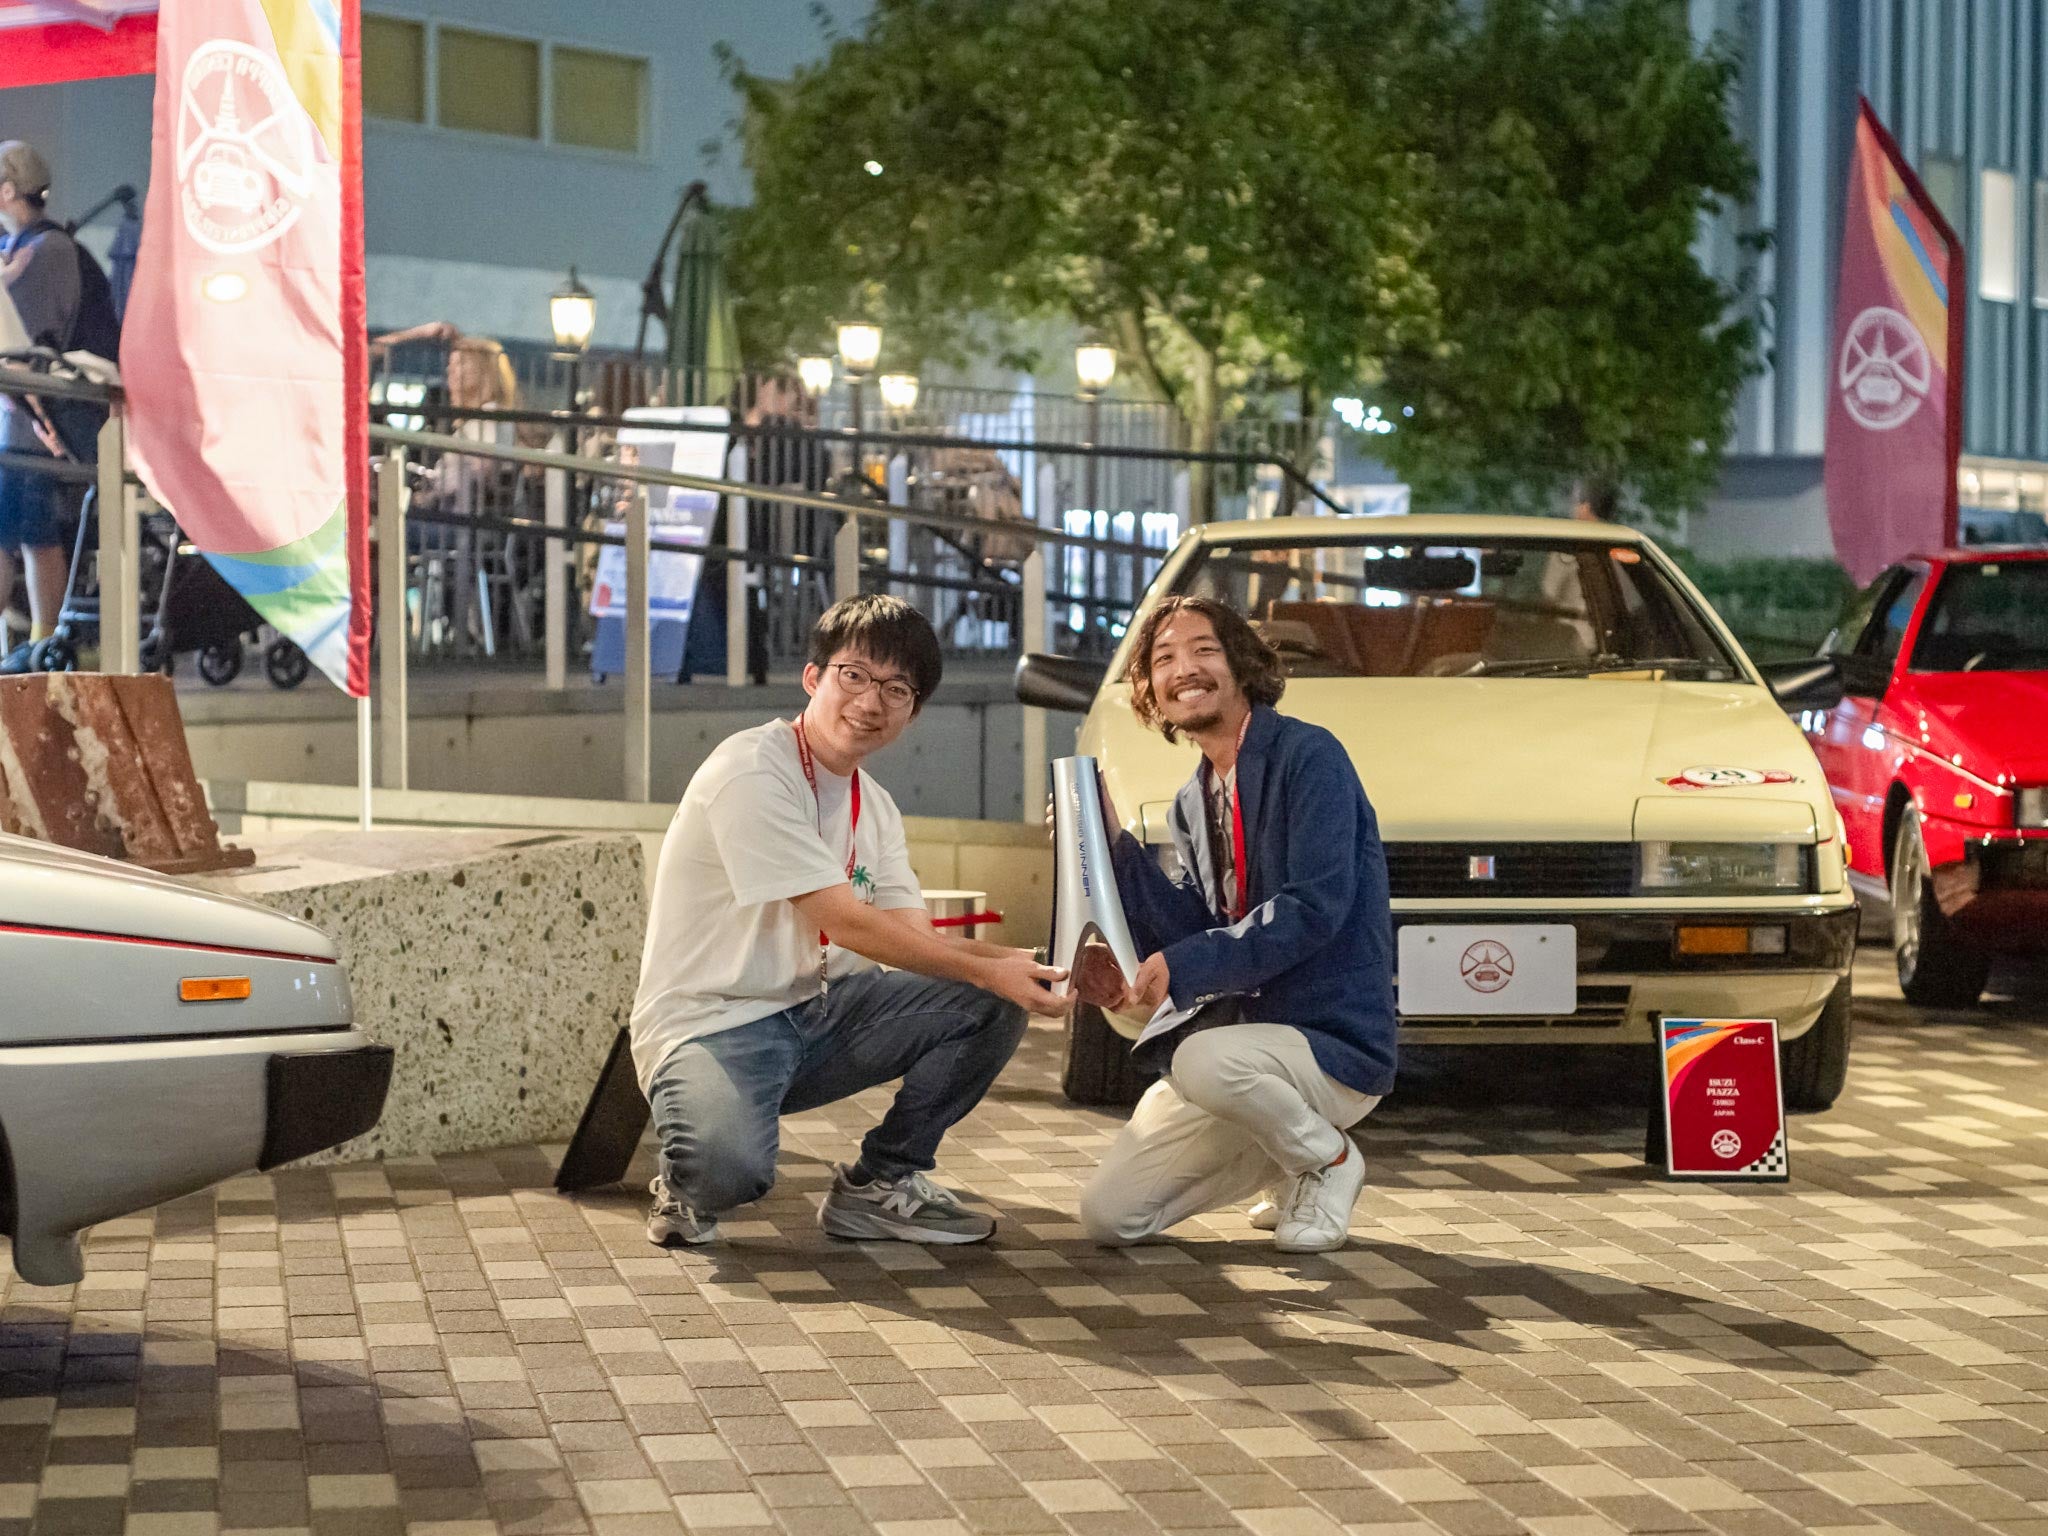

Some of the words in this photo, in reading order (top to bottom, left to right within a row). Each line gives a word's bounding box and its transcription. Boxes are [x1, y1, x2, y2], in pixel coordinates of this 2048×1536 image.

[1699, 770, 1746, 781] 29
[1079, 841, 1091, 897] WINNER
[1733, 1036, 1765, 1045] Class-C
[1708, 1078, 1736, 1087] ISUZU
[1706, 1087, 1740, 1096] PIAZZA
